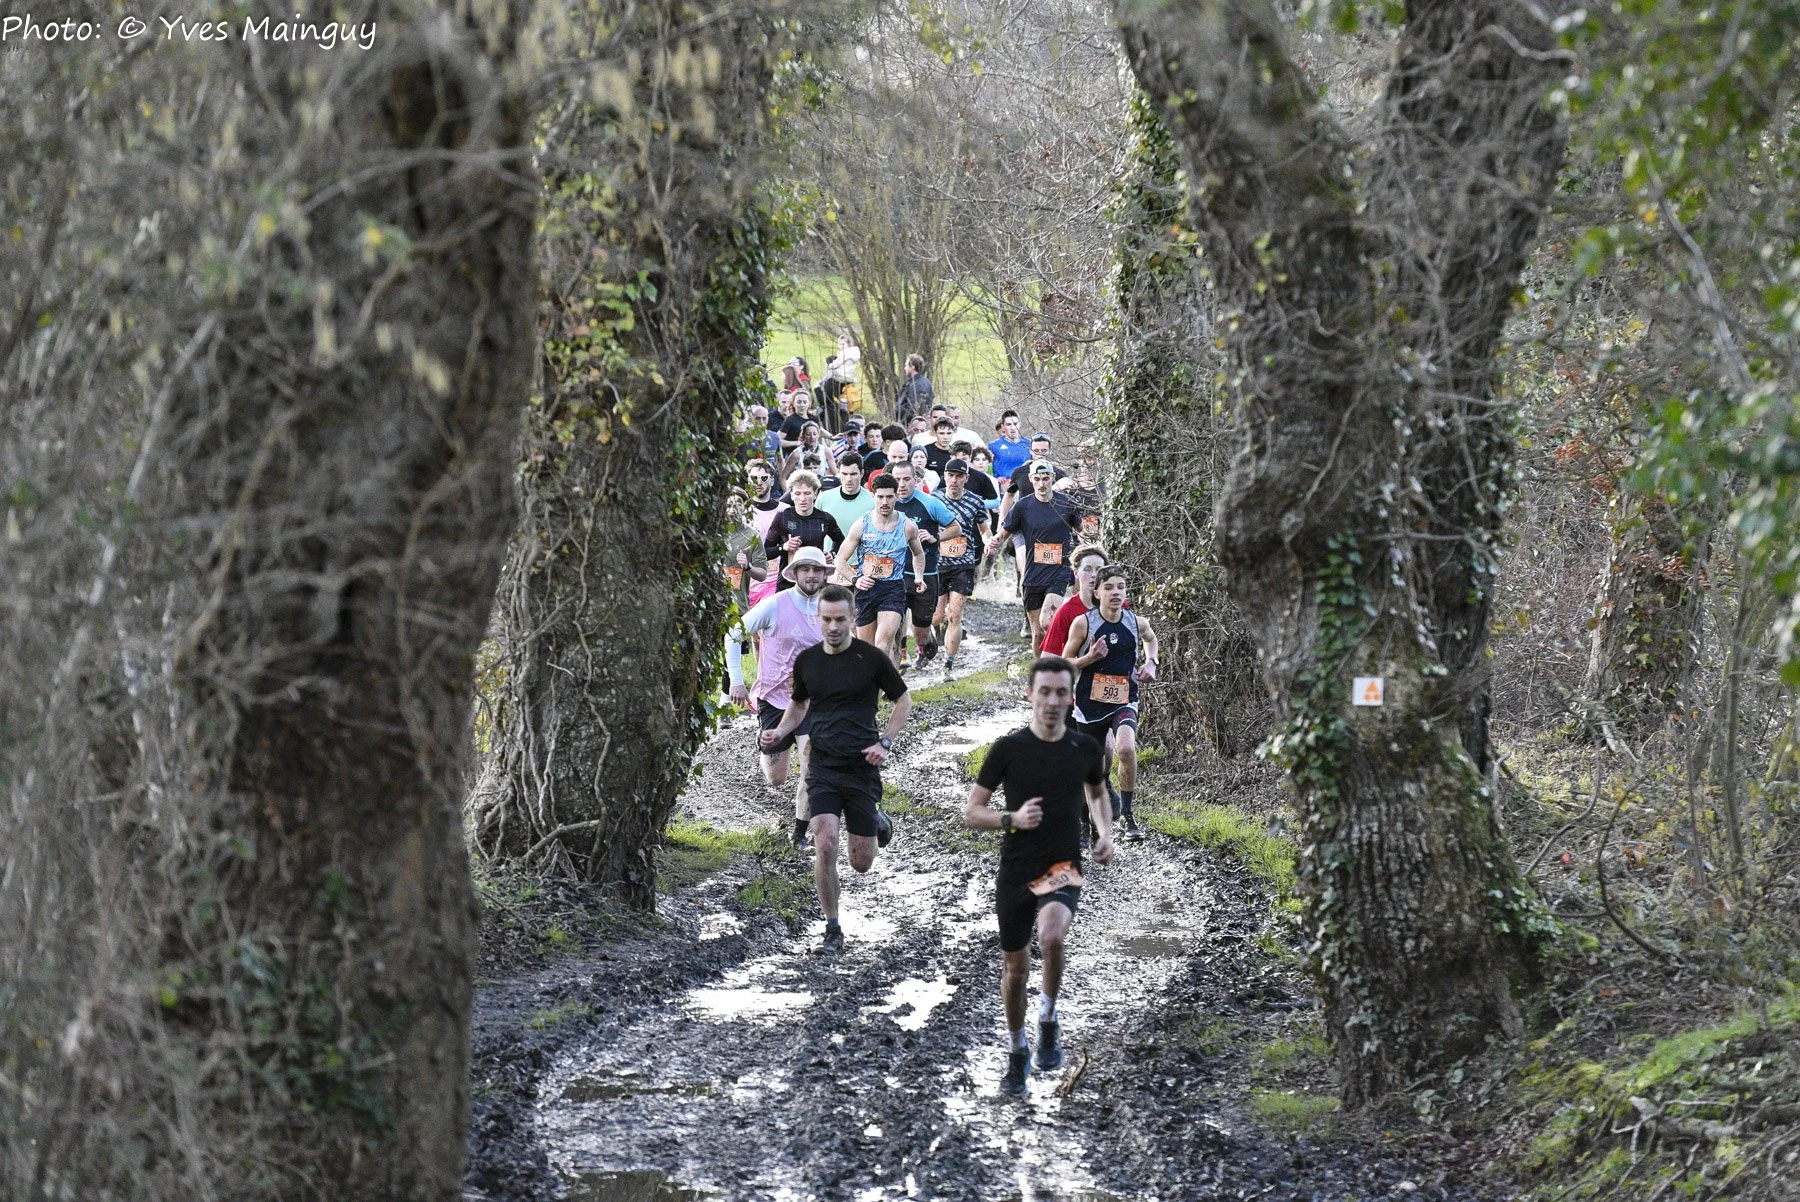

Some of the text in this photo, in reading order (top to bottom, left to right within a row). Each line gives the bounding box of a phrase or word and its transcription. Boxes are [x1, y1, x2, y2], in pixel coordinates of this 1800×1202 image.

[948, 545, 959, 553] 621
[1043, 551, 1054, 560] 601
[871, 564, 884, 574] 706
[1103, 686, 1119, 697] 503
